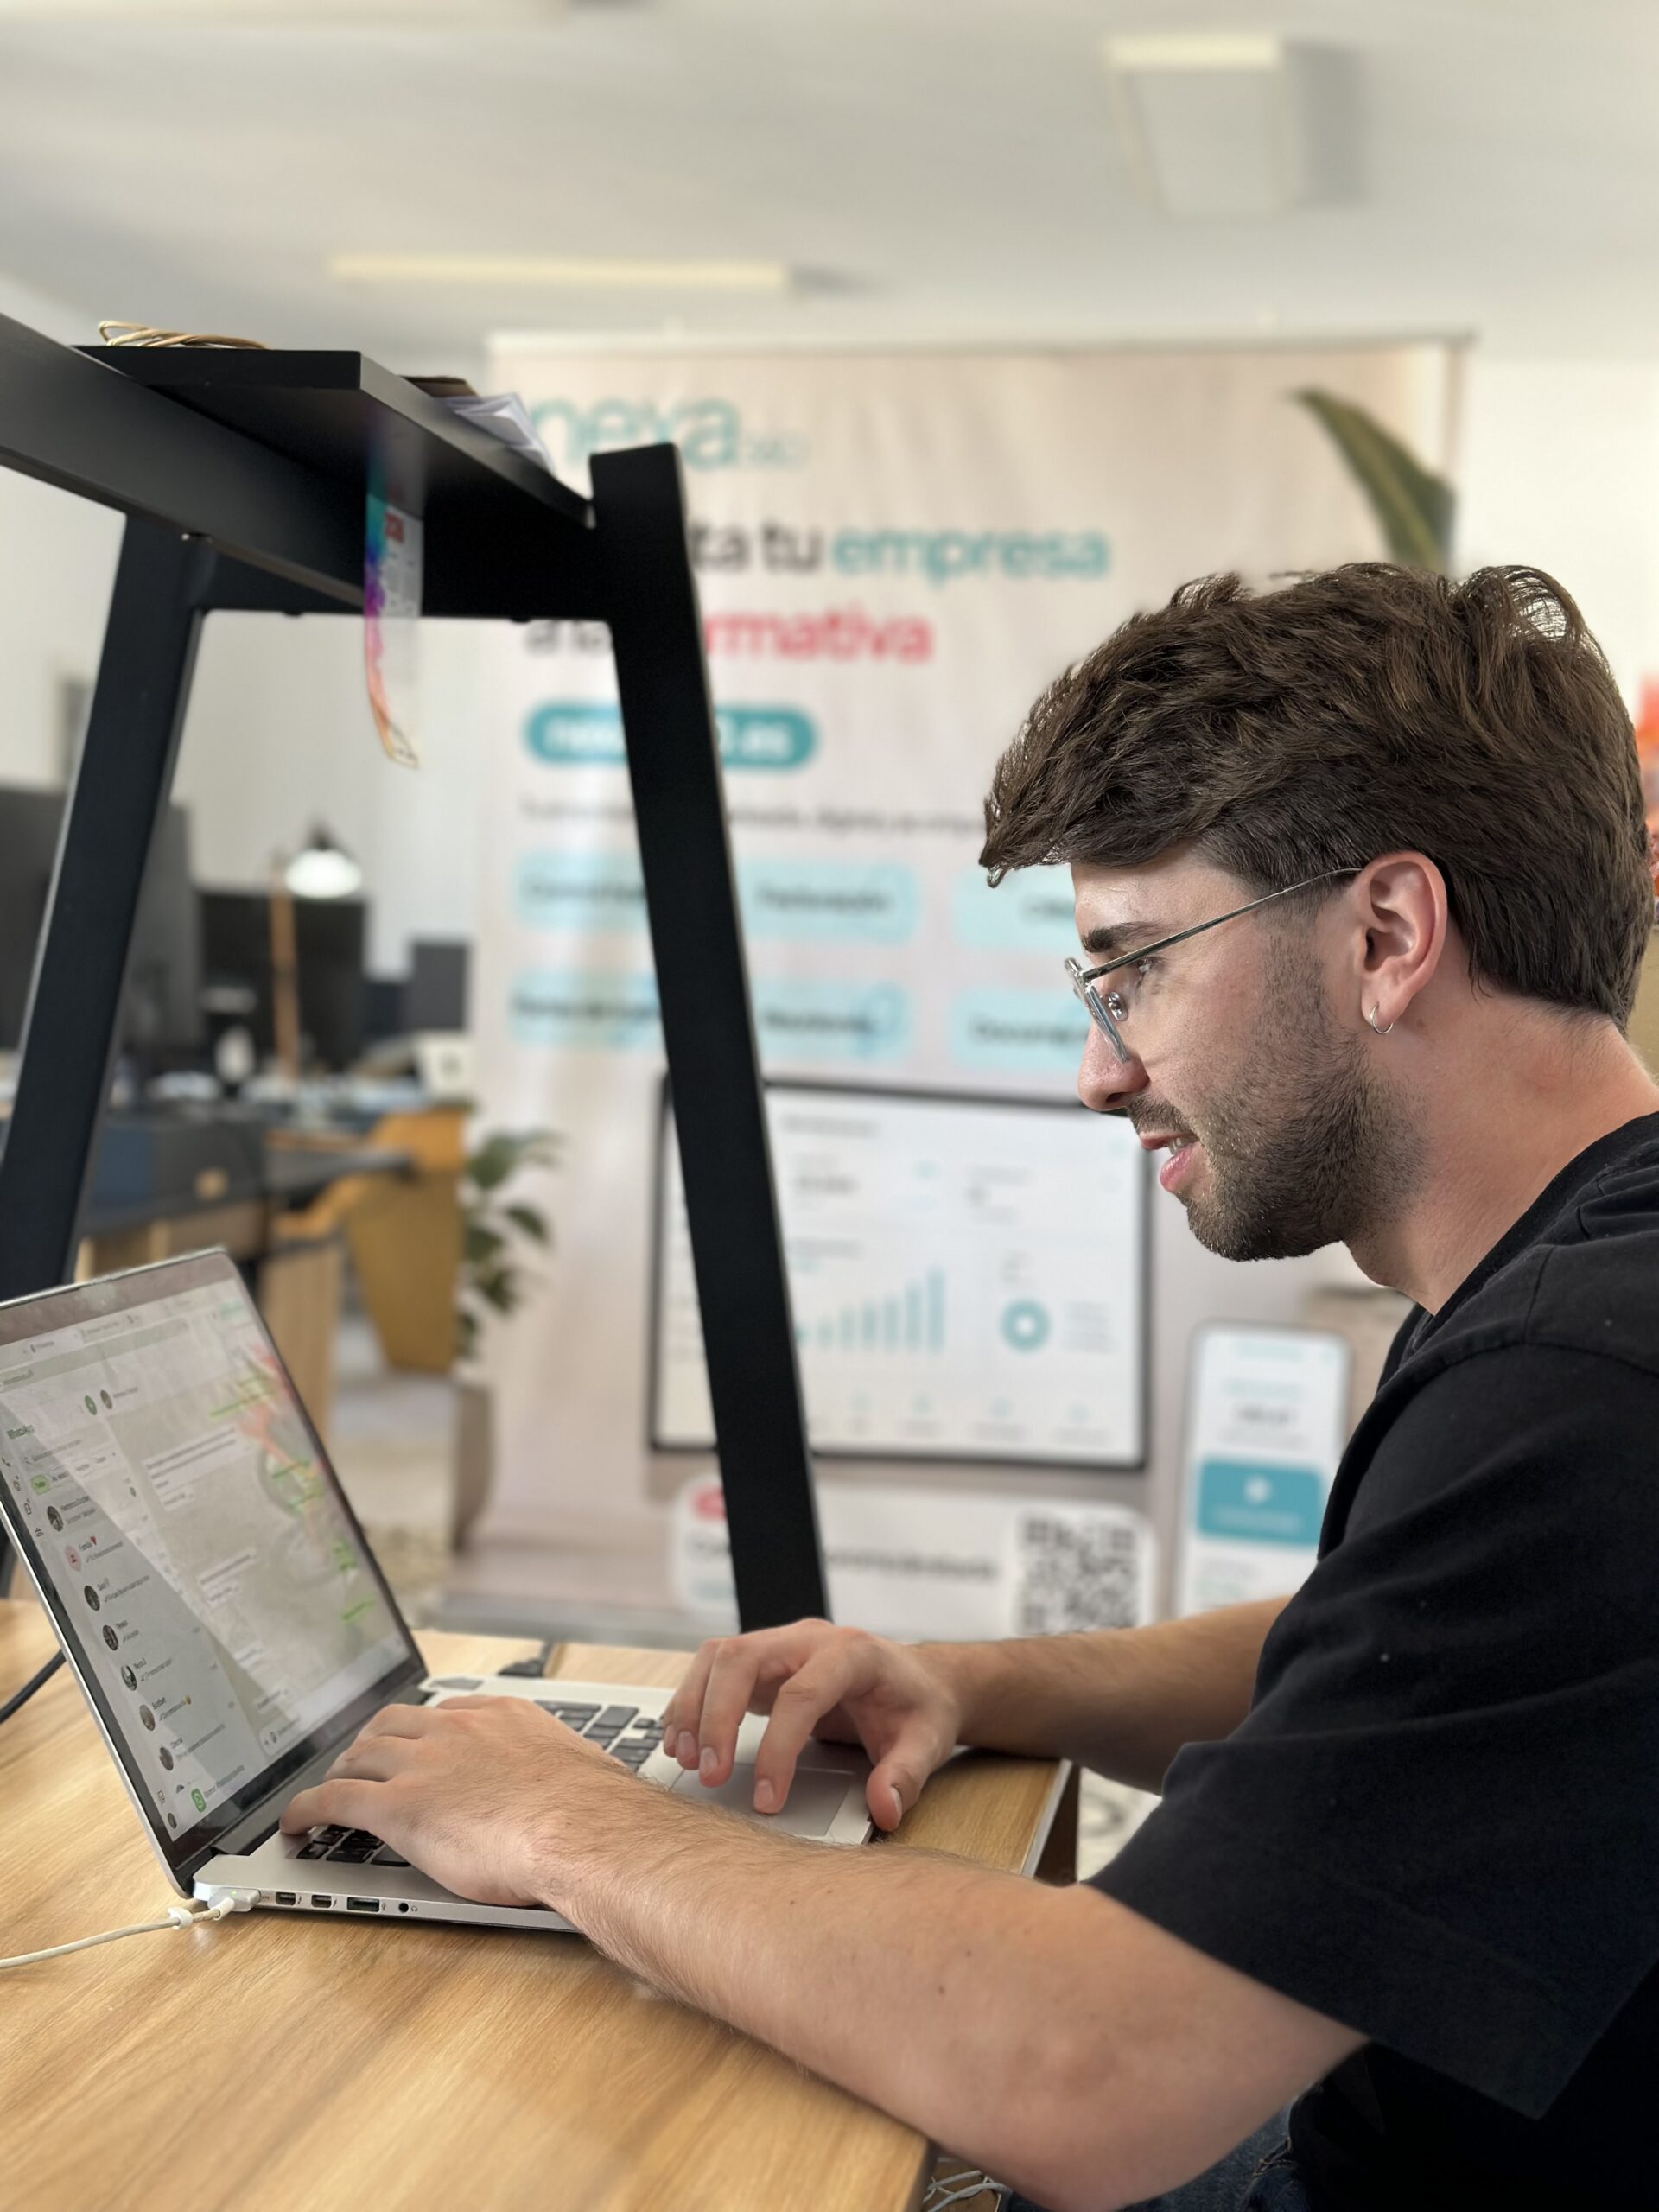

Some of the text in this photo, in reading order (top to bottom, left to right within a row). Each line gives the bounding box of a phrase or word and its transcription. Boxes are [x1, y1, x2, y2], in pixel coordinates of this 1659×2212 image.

[763, 522, 821, 572] tu
[831, 528, 1111, 589] empresa
[703, 607, 934, 664] rmativa
